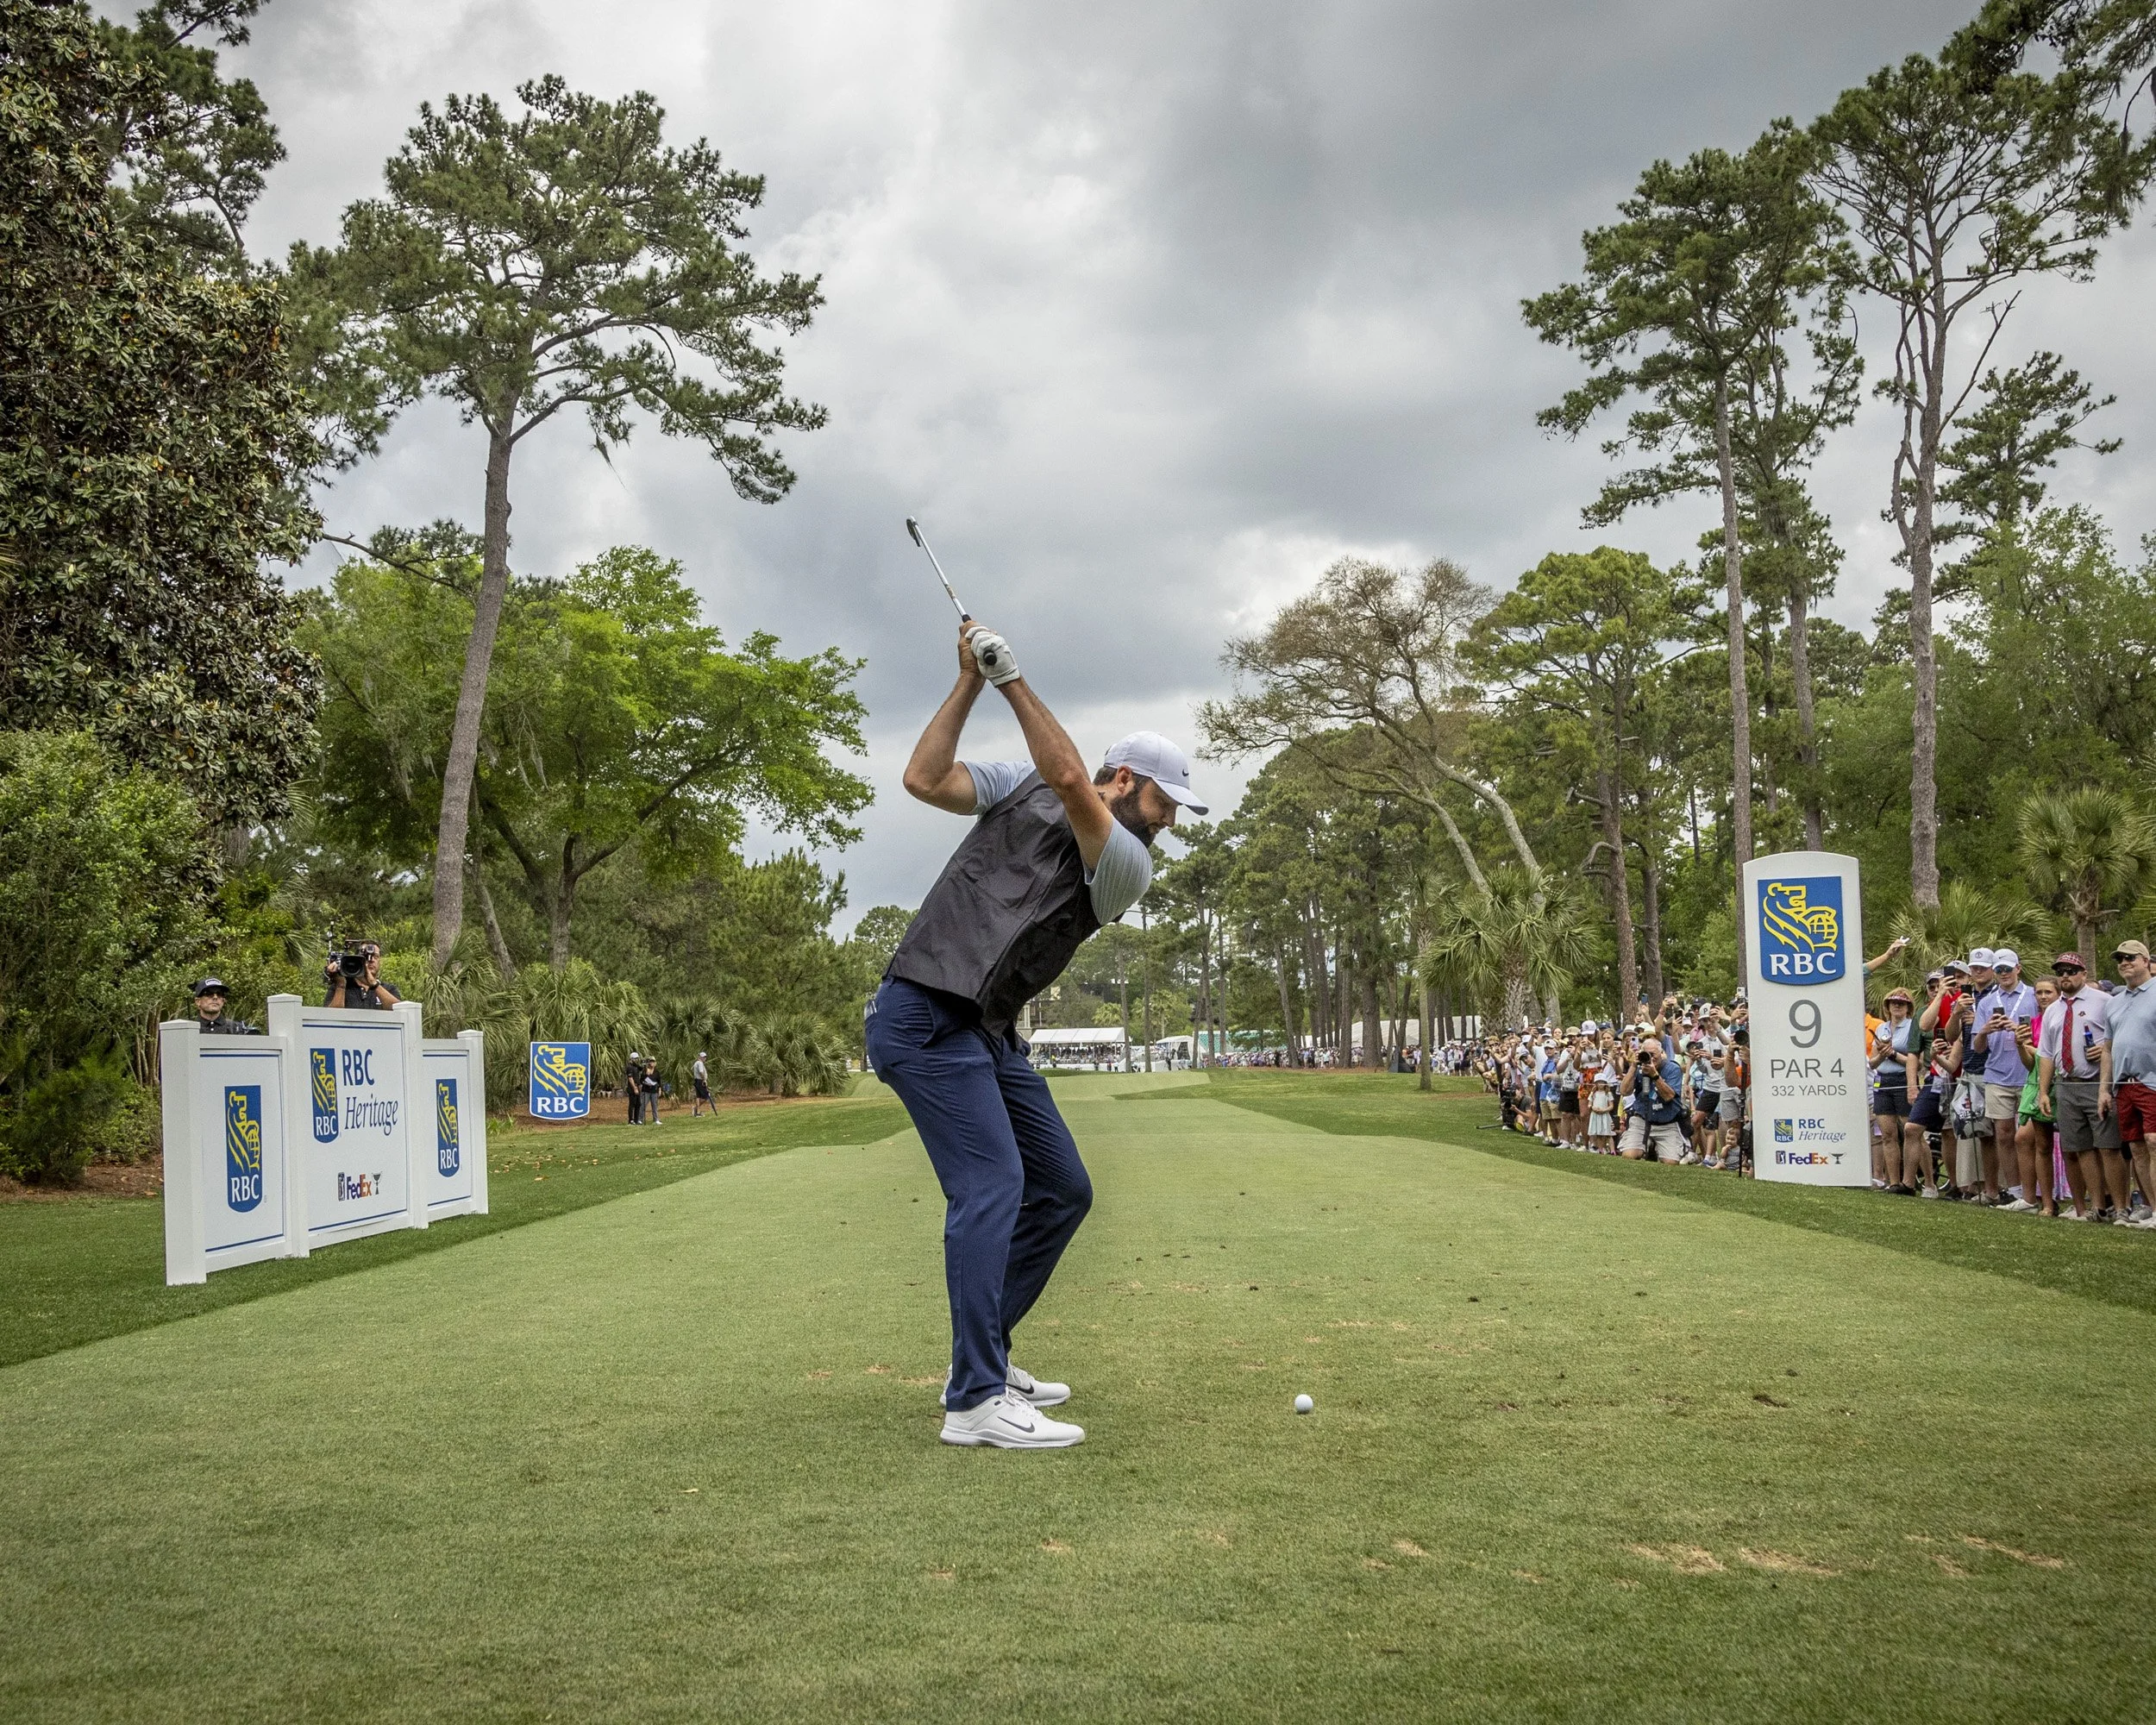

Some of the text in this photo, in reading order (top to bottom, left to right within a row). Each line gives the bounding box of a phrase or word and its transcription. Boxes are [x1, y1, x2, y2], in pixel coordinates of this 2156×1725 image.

[1770, 952, 1837, 975] RBC
[1789, 999, 1822, 1049] 9
[342, 1048, 375, 1087] RBC
[1771, 1057, 1845, 1079] PAR 4
[1771, 1084, 1847, 1096] 332 YARDS
[344, 1093, 398, 1136] Heritage
[536, 1096, 584, 1113] RBC
[316, 1115, 337, 1136] RBC
[1798, 1118, 1826, 1129] RBC
[1798, 1130, 1846, 1144] Heritage
[440, 1147, 458, 1170] RBC
[1789, 1152, 1828, 1165] FedEx
[230, 1173, 260, 1203] RBC
[346, 1173, 373, 1200] FedEx
